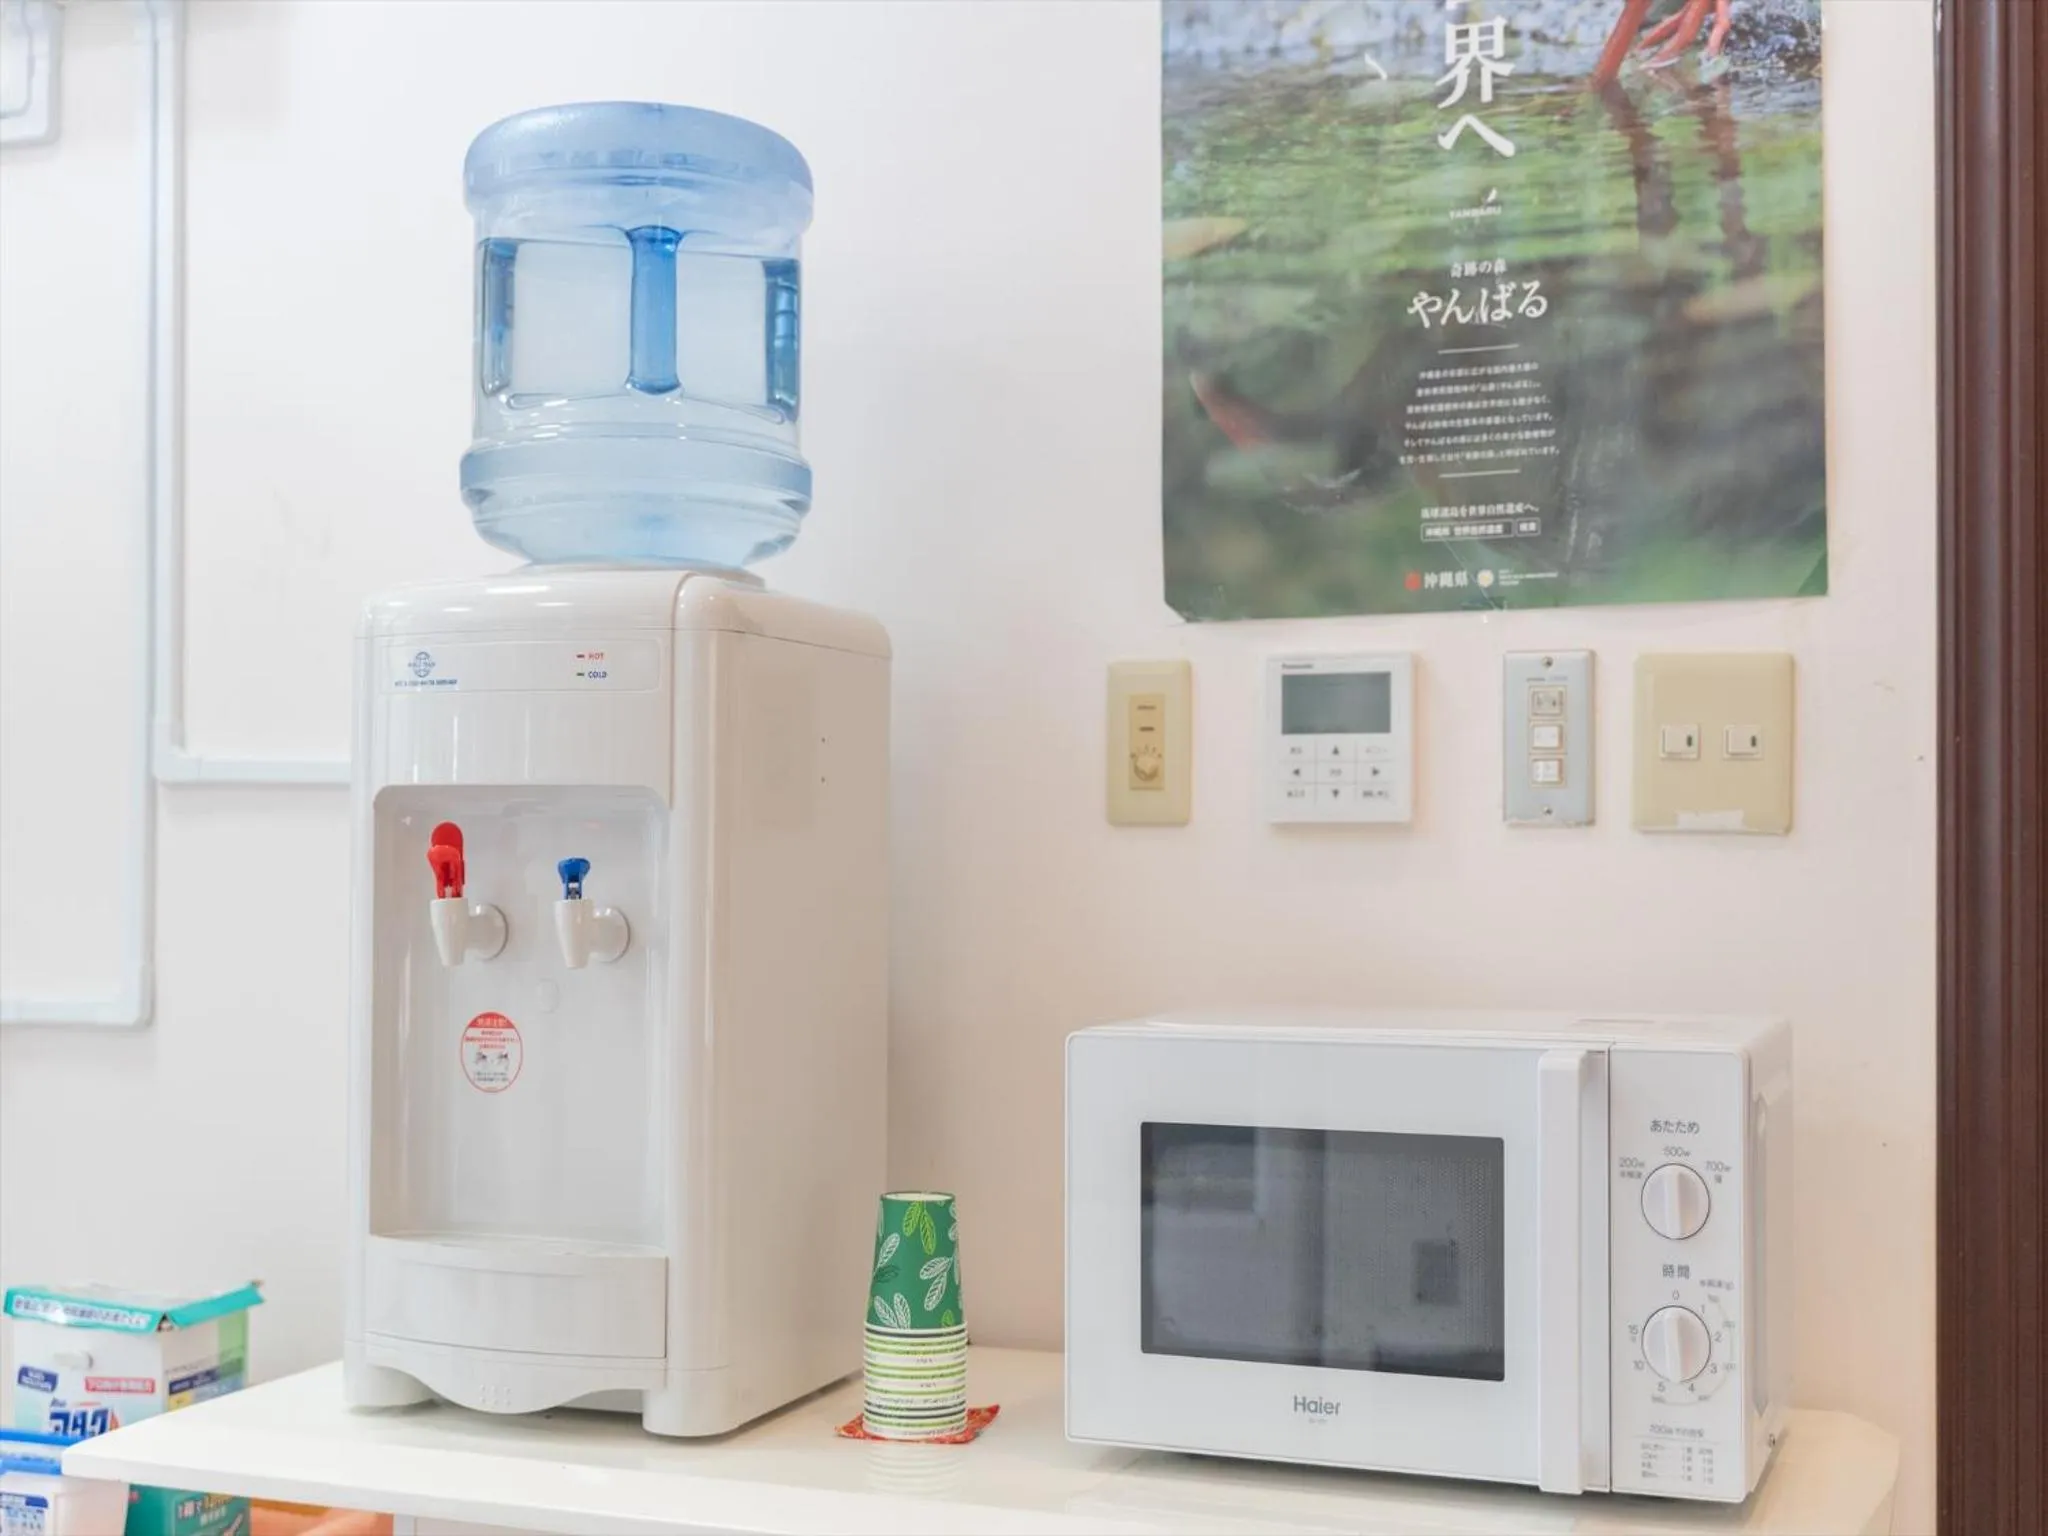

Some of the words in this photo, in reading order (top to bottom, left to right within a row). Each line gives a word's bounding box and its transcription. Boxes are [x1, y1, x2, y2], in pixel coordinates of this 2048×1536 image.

[1436, 0, 1515, 157] 界へ
[1450, 258, 1507, 278] 奇跡の森
[1406, 280, 1548, 329] やんばる
[1424, 571, 1468, 590] 沖縄県
[588, 670, 607, 679] COLD
[1650, 1120, 1700, 1134] あたため
[1663, 1264, 1690, 1279] 時間
[1294, 1395, 1340, 1415] Haier
